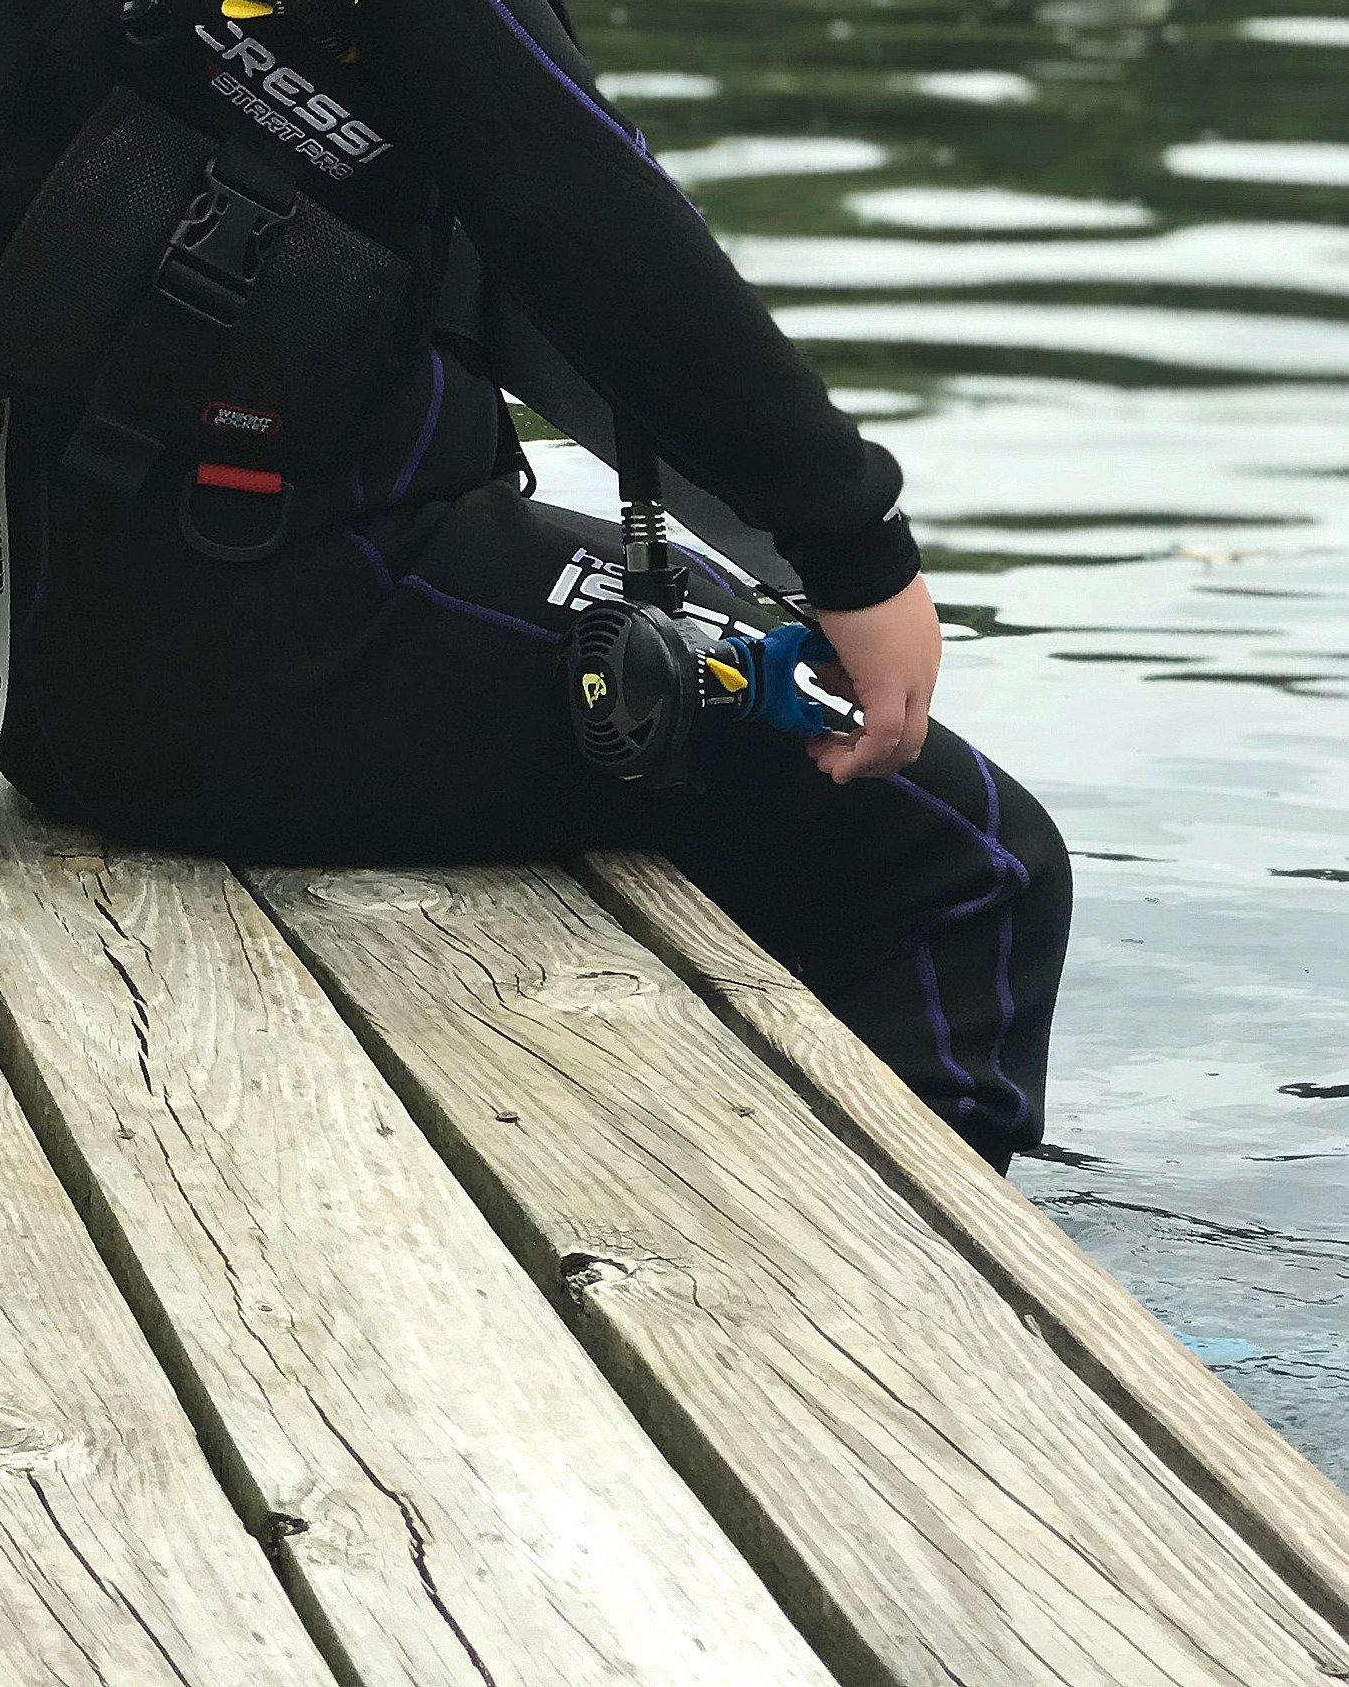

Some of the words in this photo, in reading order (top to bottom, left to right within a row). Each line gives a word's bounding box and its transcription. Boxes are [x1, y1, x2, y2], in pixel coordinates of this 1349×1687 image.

[195, 21, 394, 163] CRESSI
[211, 72, 306, 142] START
[296, 139, 354, 180] PRO
